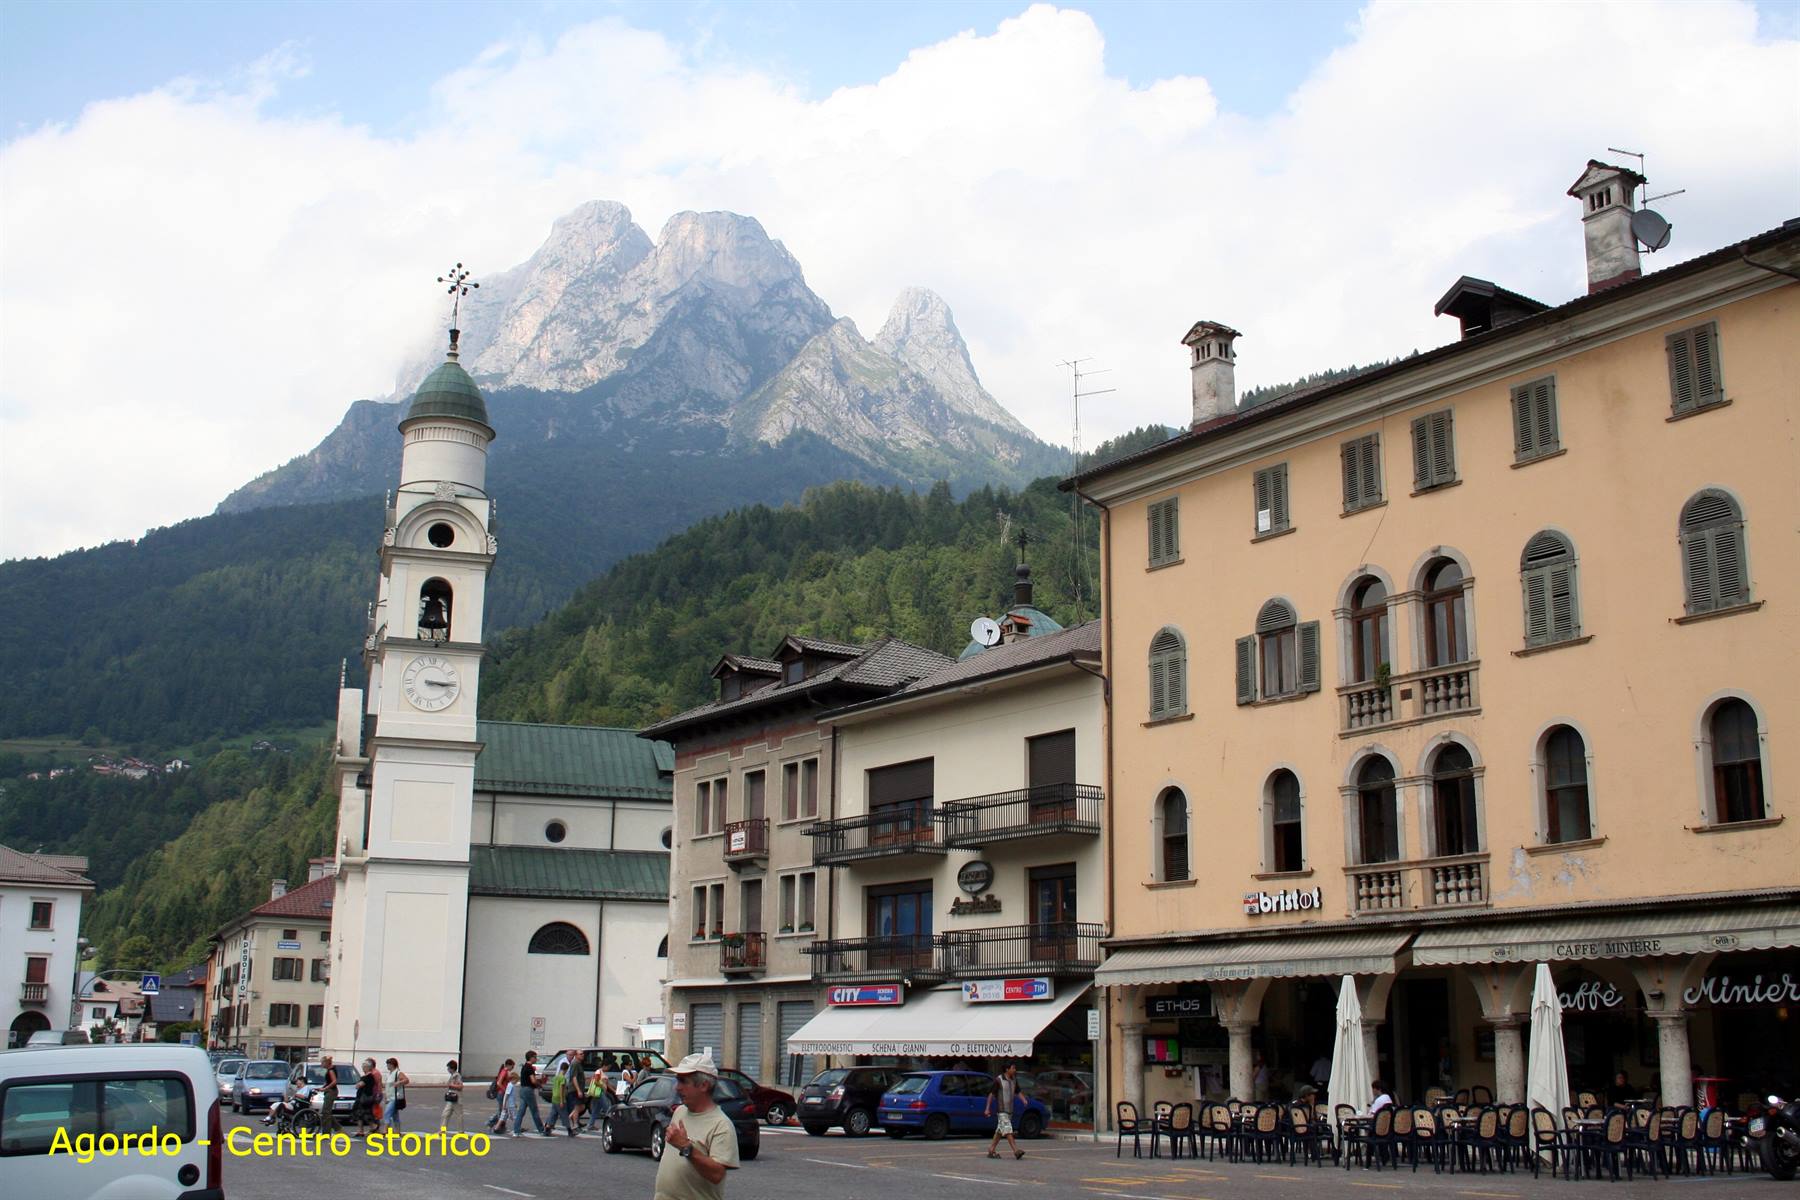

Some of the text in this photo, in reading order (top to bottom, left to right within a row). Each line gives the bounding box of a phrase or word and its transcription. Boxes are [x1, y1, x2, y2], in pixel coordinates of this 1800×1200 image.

[1259, 886, 1321, 913] bristot
[1605, 940, 1662, 954] MINIERE
[240, 941, 249, 991] pegoraro
[834, 987, 862, 1003] CITY
[1005, 986, 1022, 994] CENTRO
[1033, 984, 1046, 993] TIM
[1557, 981, 1623, 1011] affè
[1155, 999, 1200, 1012] ETHOS
[801, 1043, 853, 1053] ELETTRODOMESTICI
[872, 1043, 897, 1053] SCHENA
[902, 1043, 927, 1053] GIANNI
[966, 1043, 1013, 1053] ELETTRONICA
